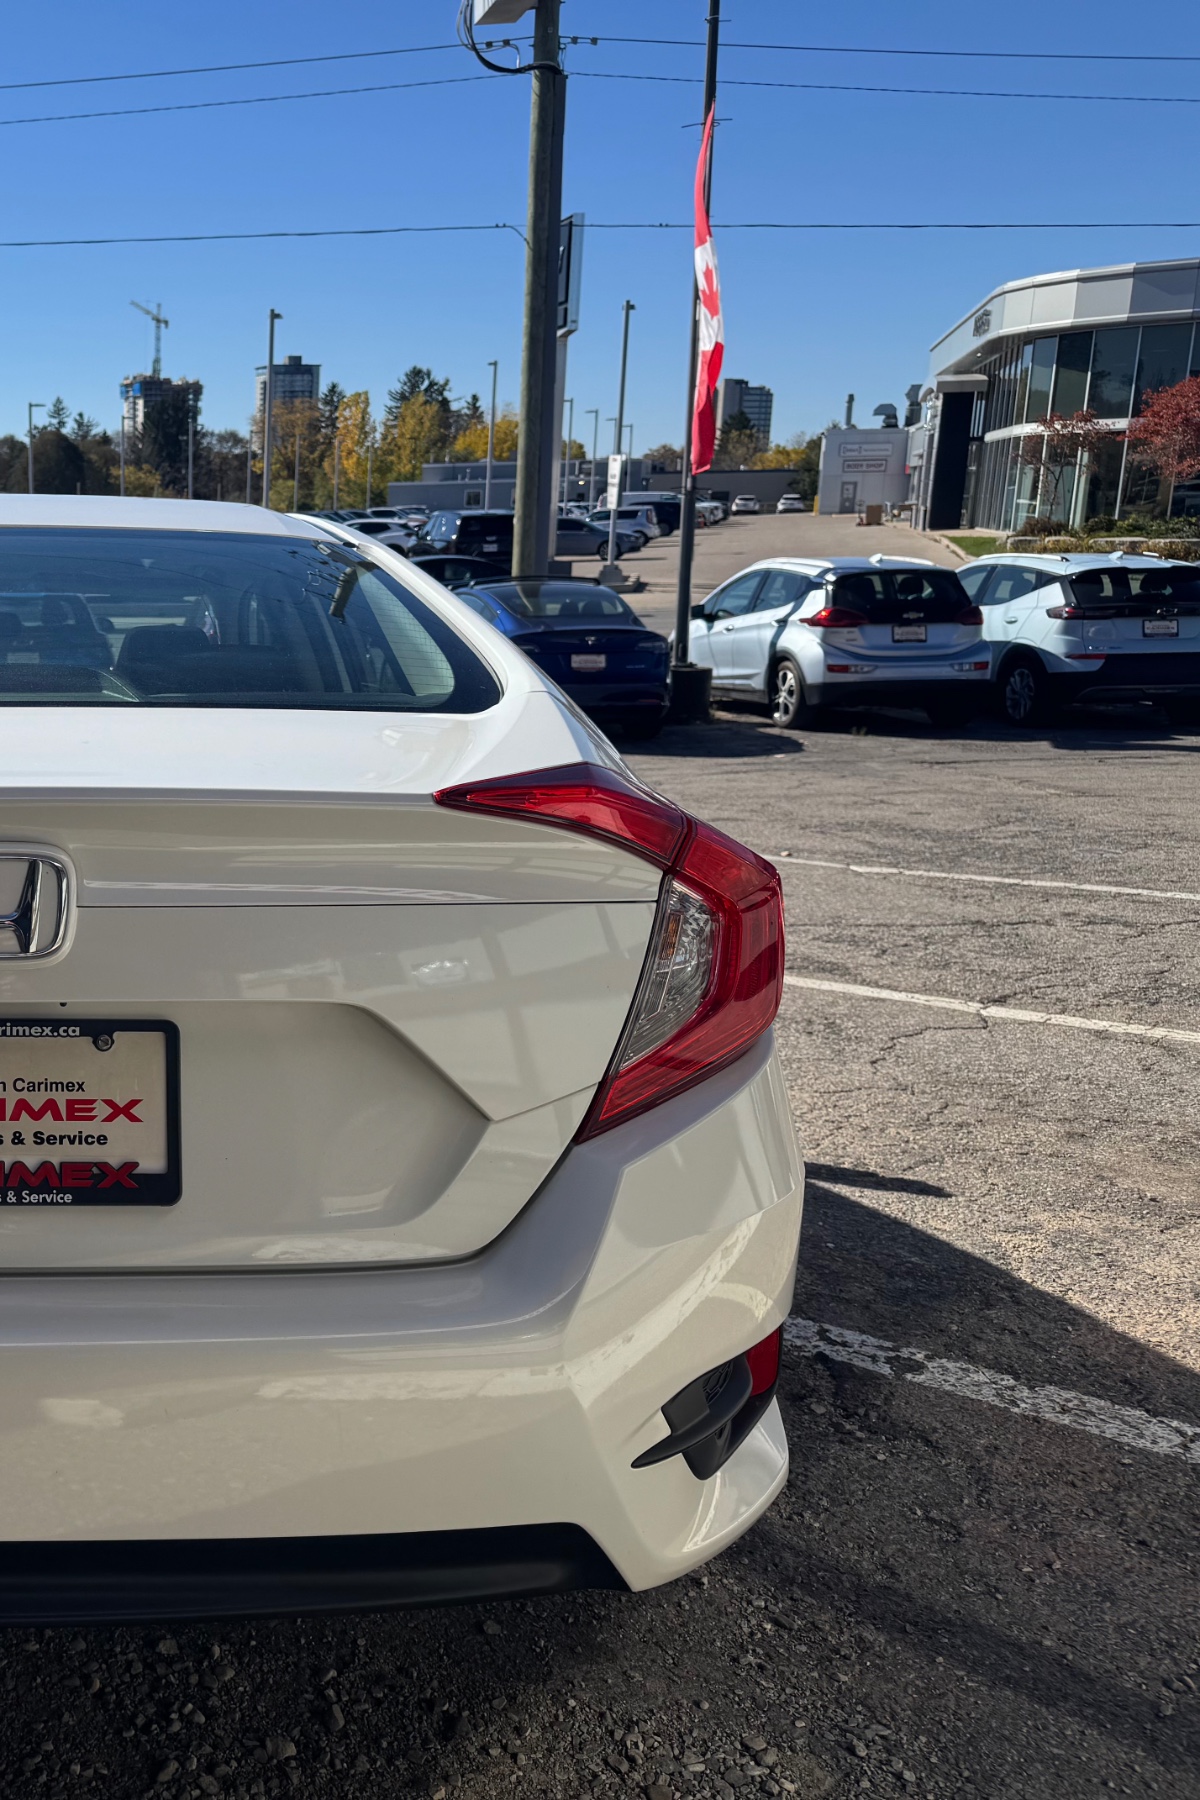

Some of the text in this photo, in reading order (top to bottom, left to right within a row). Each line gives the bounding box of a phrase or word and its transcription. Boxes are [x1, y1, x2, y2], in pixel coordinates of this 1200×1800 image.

[12, 1077, 86, 1093] Carimex
[10, 1131, 26, 1146] &
[32, 1131, 109, 1146] Service
[6, 1190, 17, 1204] &
[21, 1190, 73, 1204] Service
